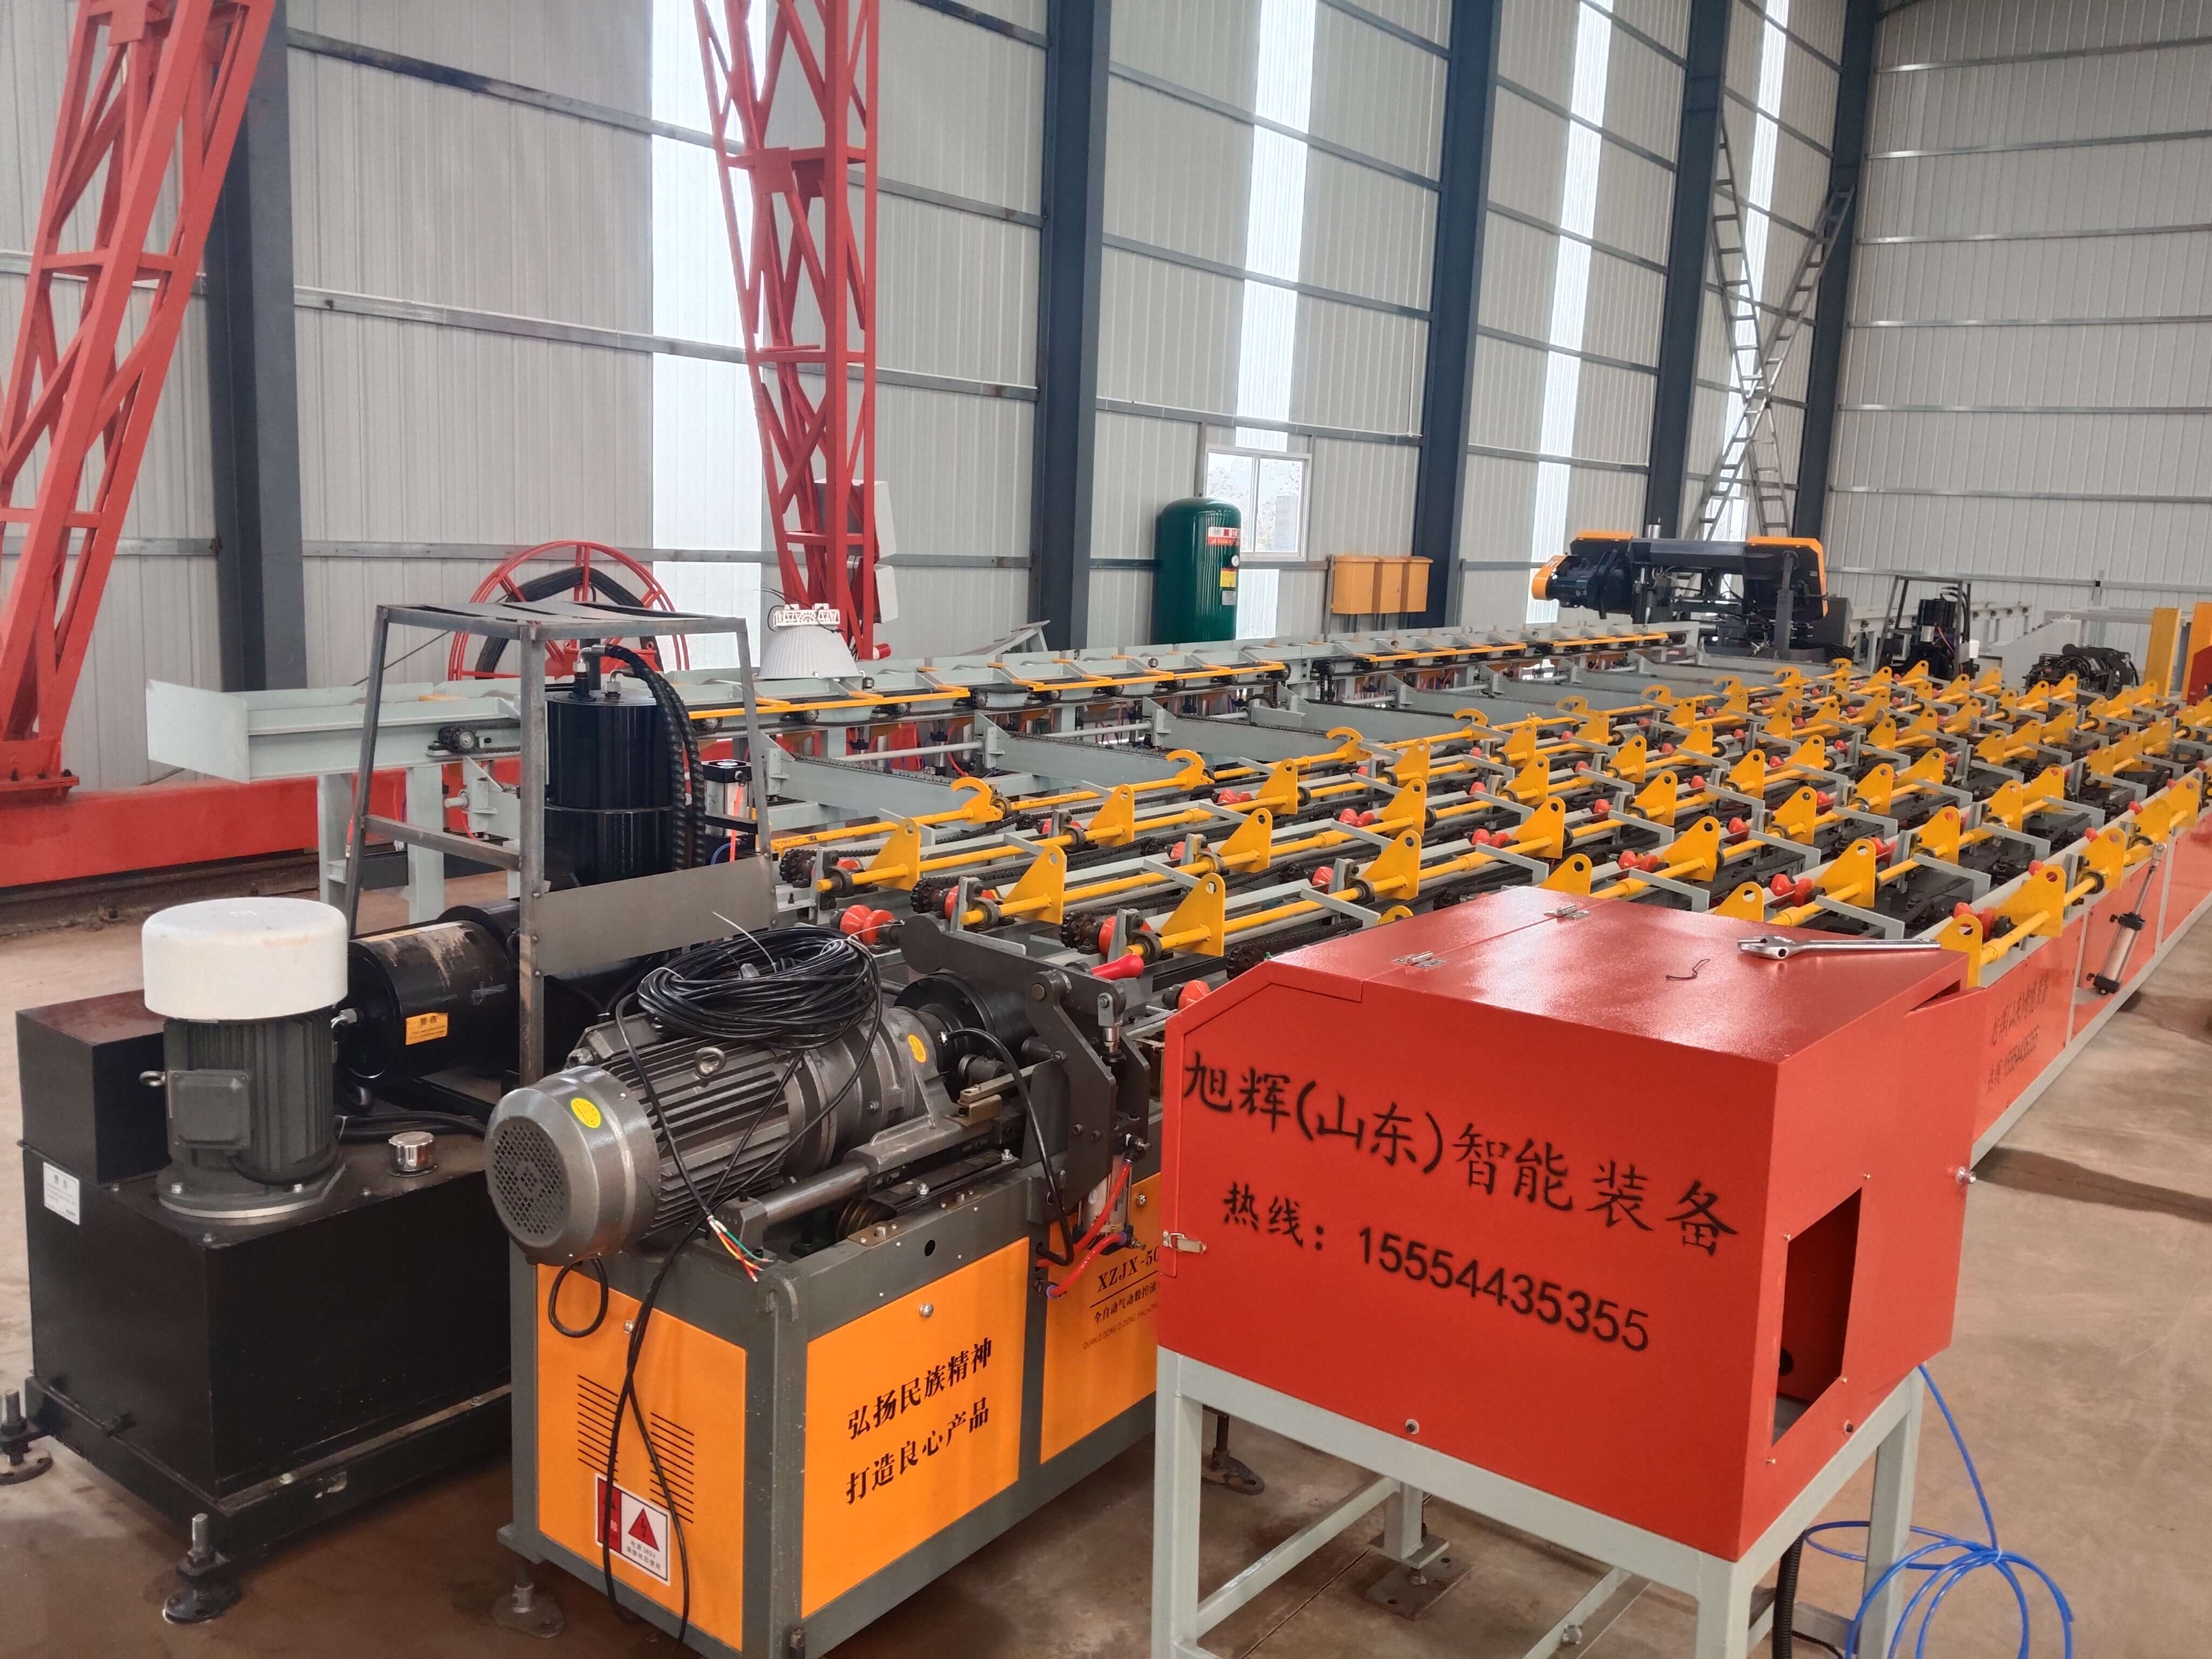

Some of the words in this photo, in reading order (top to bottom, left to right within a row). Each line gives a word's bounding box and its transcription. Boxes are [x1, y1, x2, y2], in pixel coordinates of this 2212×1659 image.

[1358, 1226, 1650, 1353] 15554435355
[847, 1337, 992, 1440] 弘扬民族精神
[846, 1397, 989, 1505] 打造良心产品
